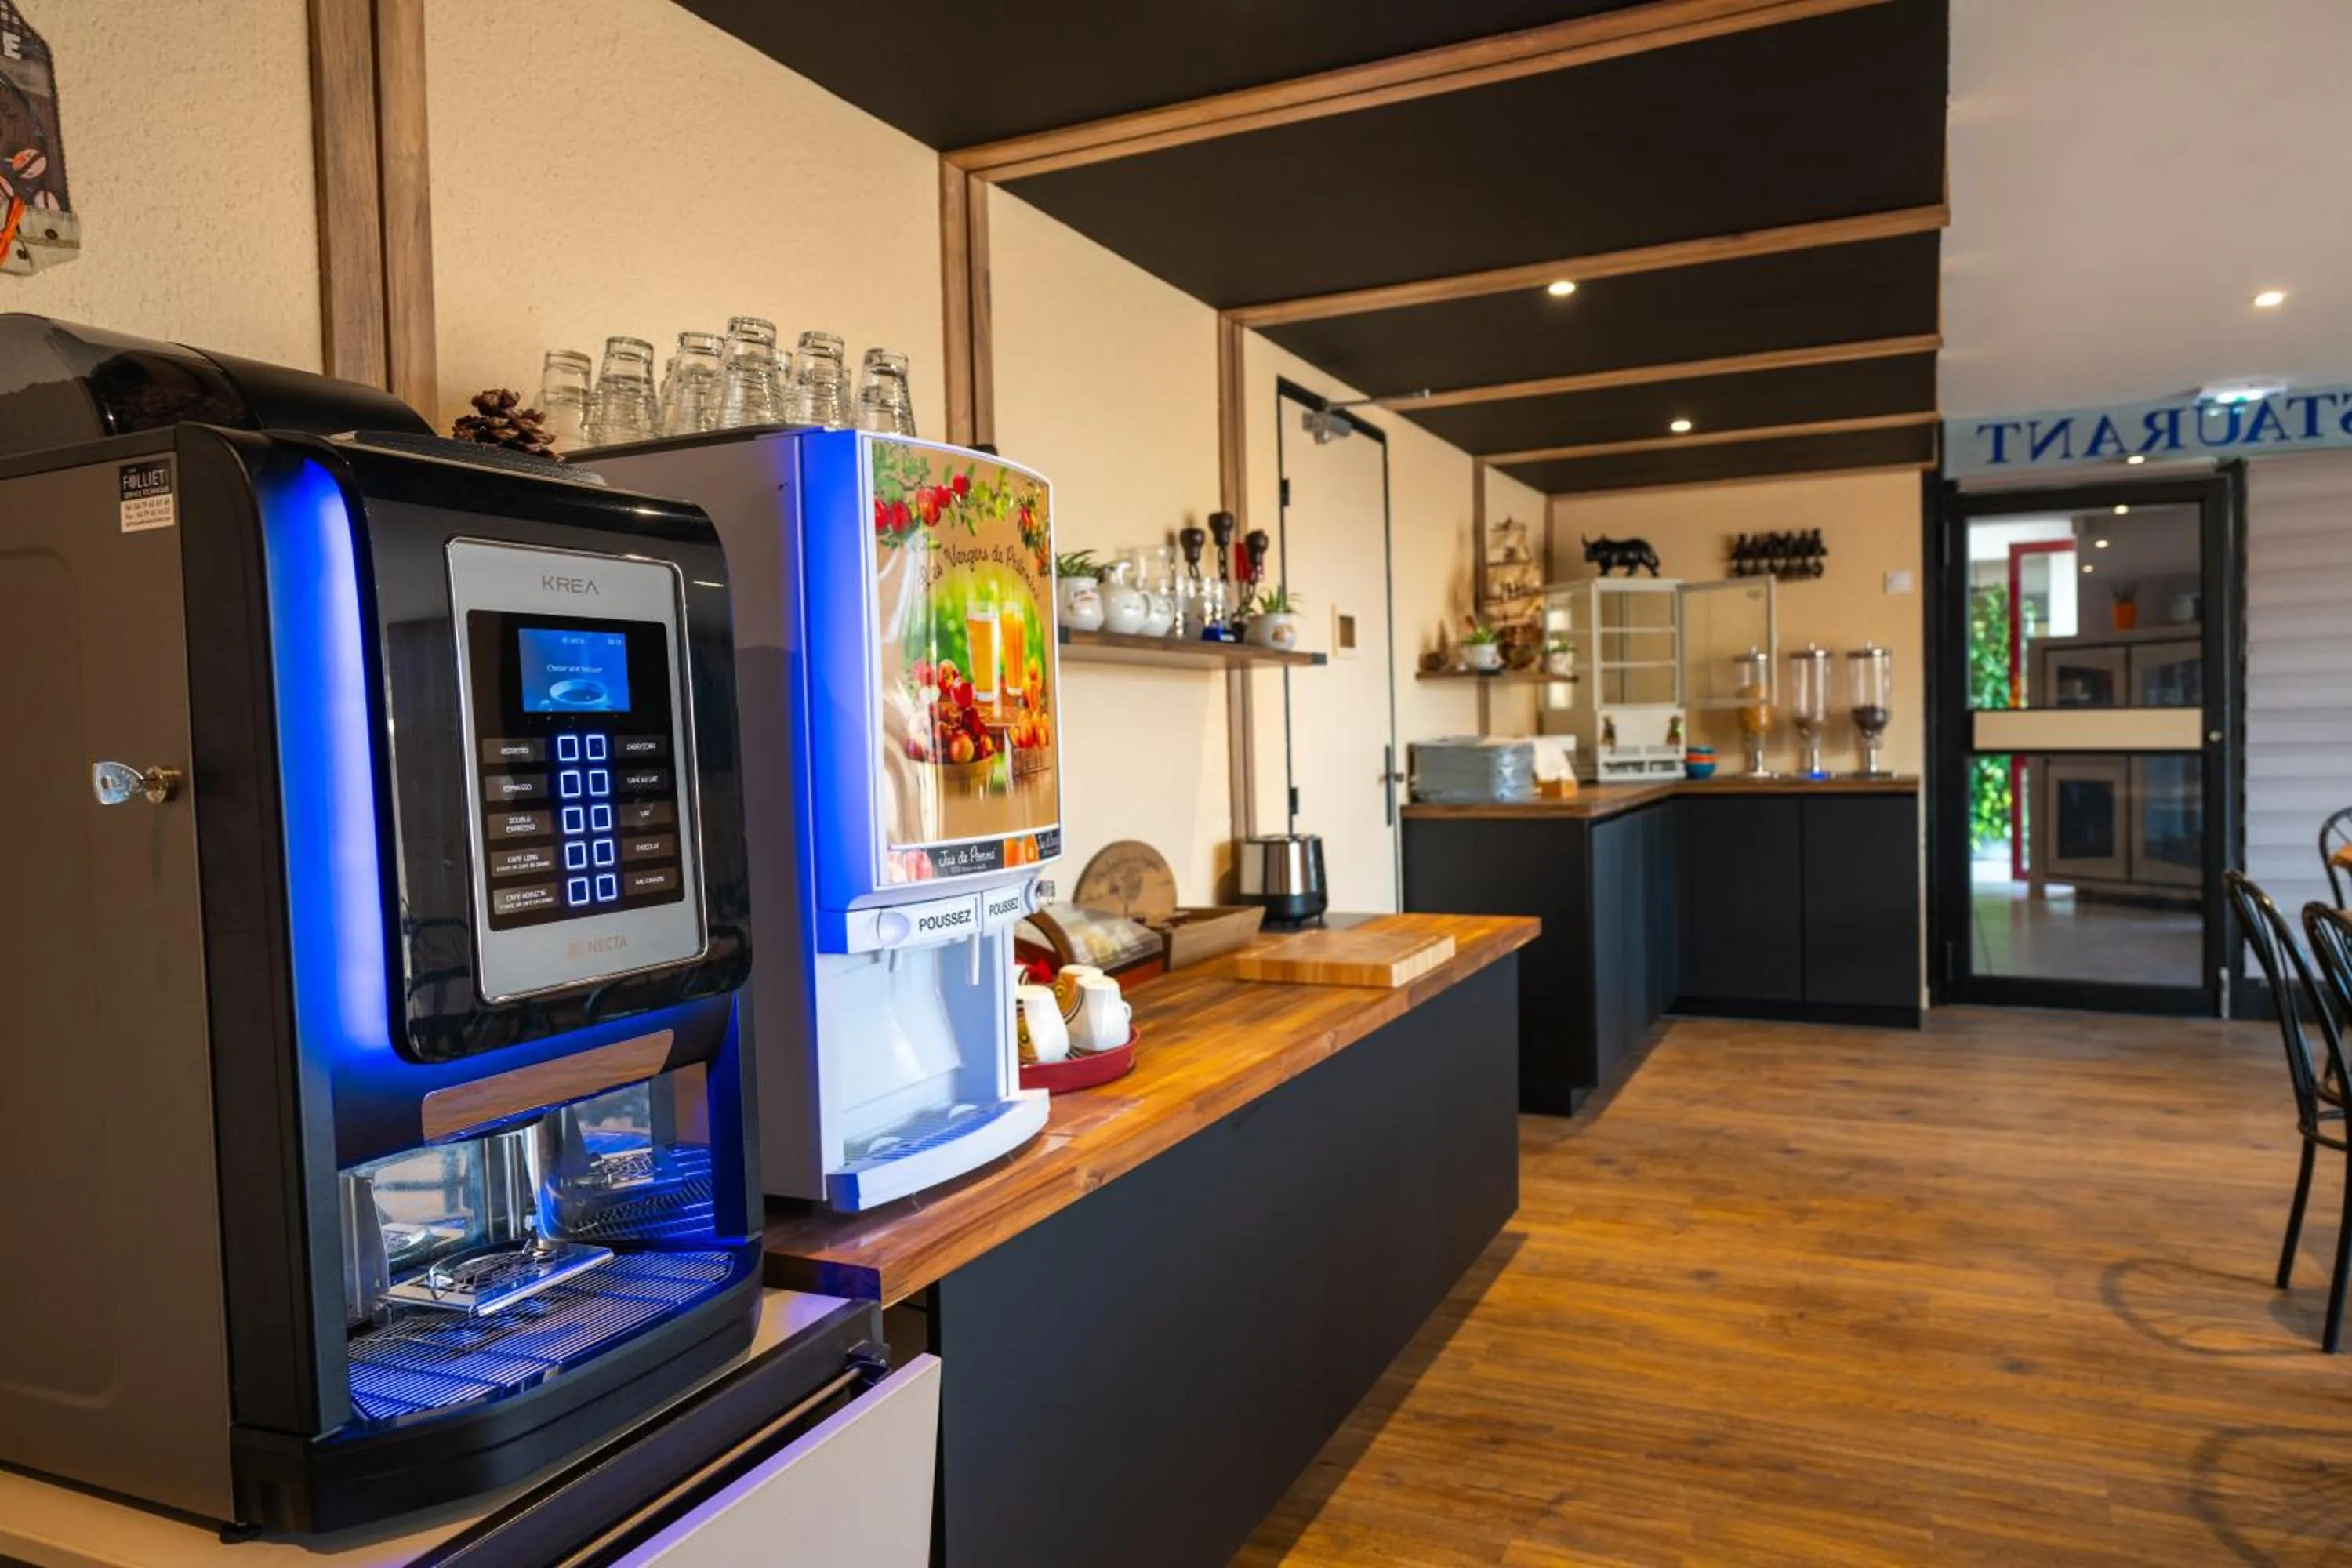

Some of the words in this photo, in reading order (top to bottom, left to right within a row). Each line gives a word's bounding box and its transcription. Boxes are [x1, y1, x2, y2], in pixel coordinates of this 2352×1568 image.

[542, 575, 600, 595] KREA
[938, 849, 956, 867] Jus
[958, 850, 968, 863] de
[919, 909, 972, 931] POUSSEZ
[989, 897, 1019, 916] POUSSEZ
